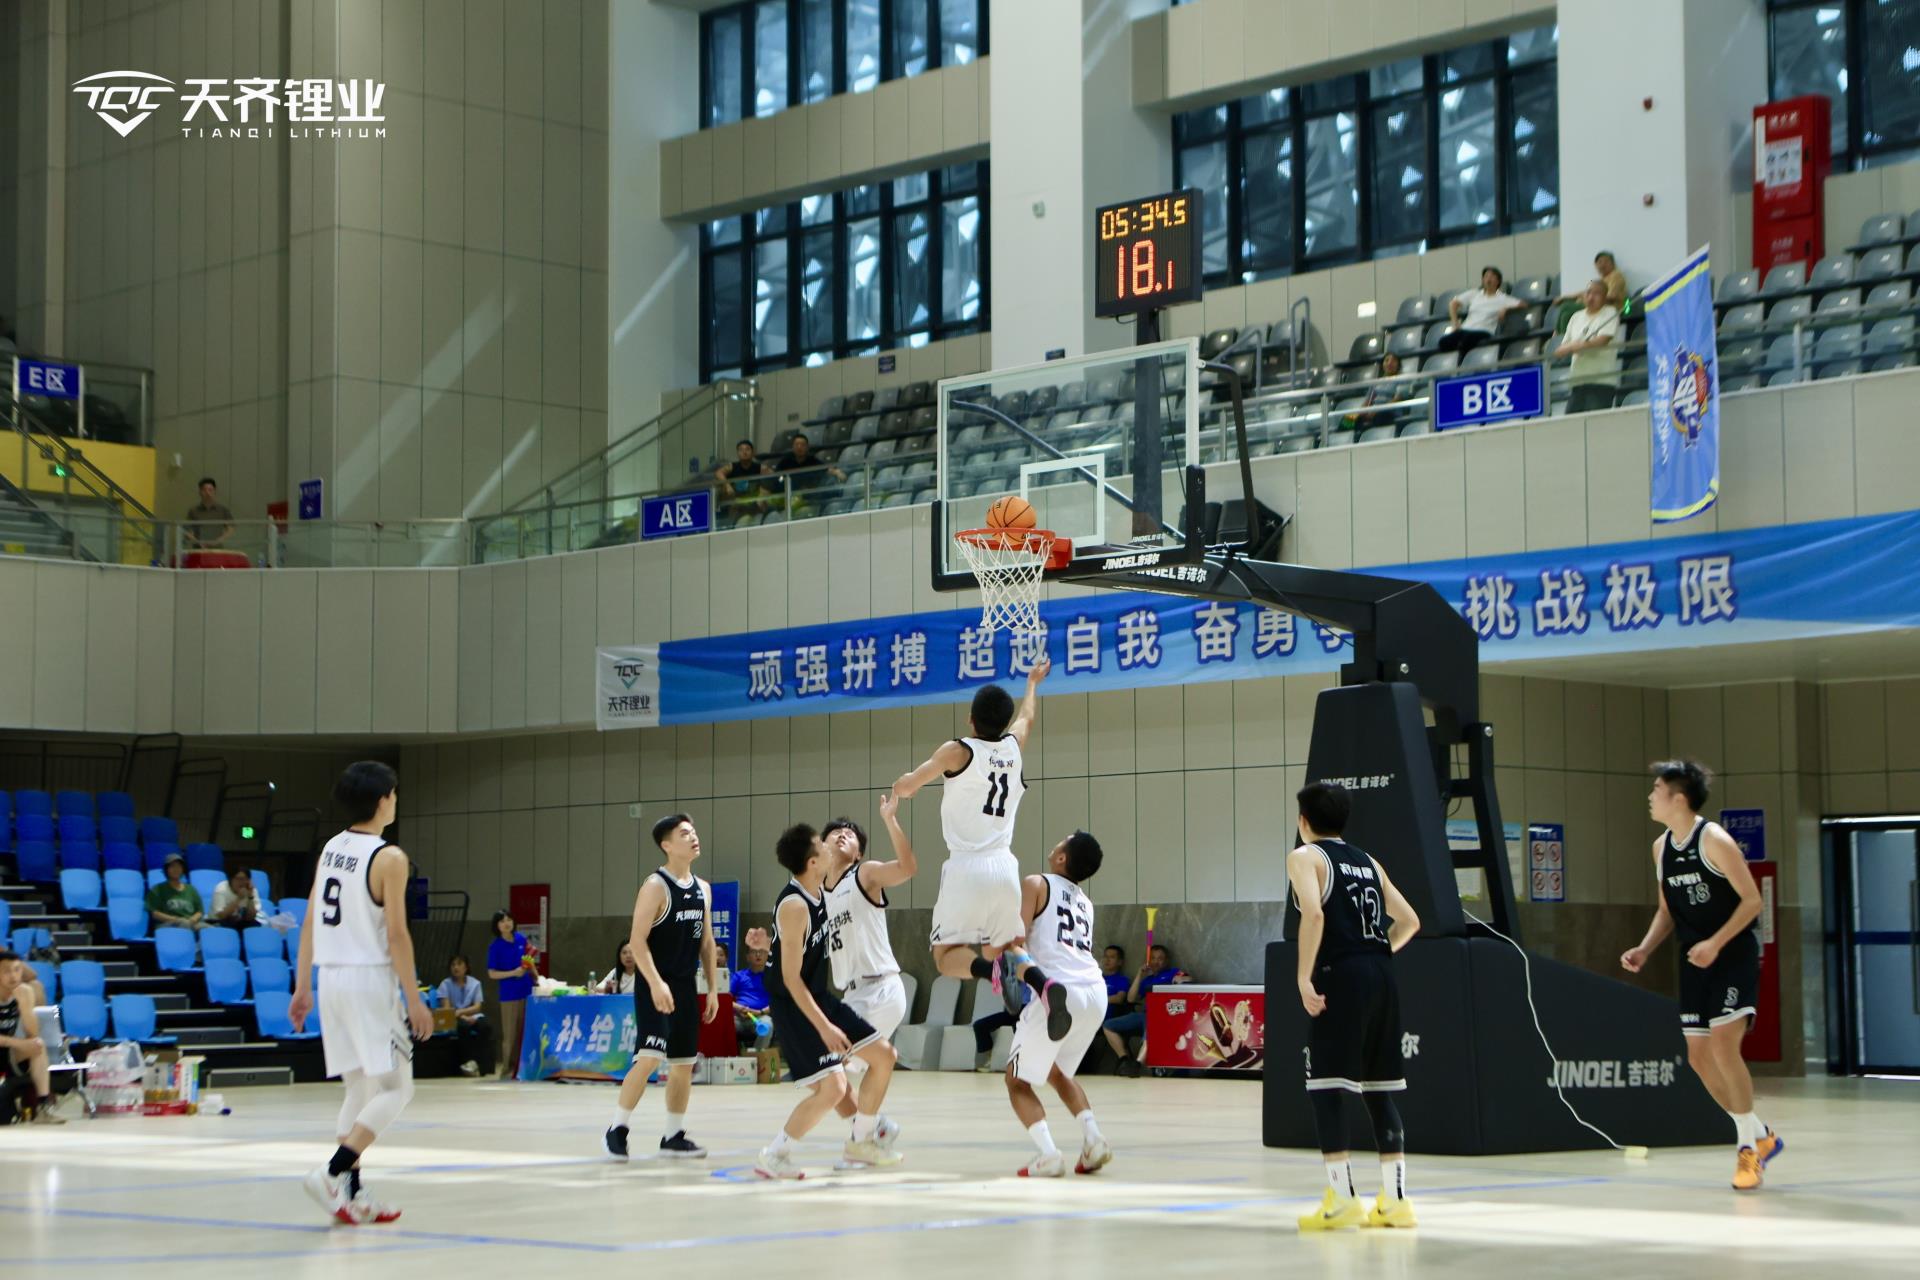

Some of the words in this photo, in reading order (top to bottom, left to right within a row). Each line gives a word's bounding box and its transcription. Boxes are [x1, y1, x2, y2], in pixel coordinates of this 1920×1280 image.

[1102, 199, 1186, 240] 05:34.5
[1118, 240, 1174, 299] 18.1
[29, 366, 66, 392] E区
[1462, 377, 1514, 416] B区
[659, 499, 694, 529] A区
[1102, 556, 1138, 571] JINOEL
[1177, 566, 1208, 583] 吉诺尔
[749, 632, 927, 698] 顽强拼搏
[958, 610, 1161, 680] 超越自我
[1466, 556, 1735, 637] 挑战极限
[608, 695, 651, 712] 天齐锂业
[982, 771, 1009, 817] 11
[322, 877, 342, 926] 9
[692, 920, 704, 938] 2
[1056, 905, 1091, 952] 23
[1547, 1060, 1626, 1088] JINOEL
[1627, 1059, 1675, 1087] 吉诺尔
